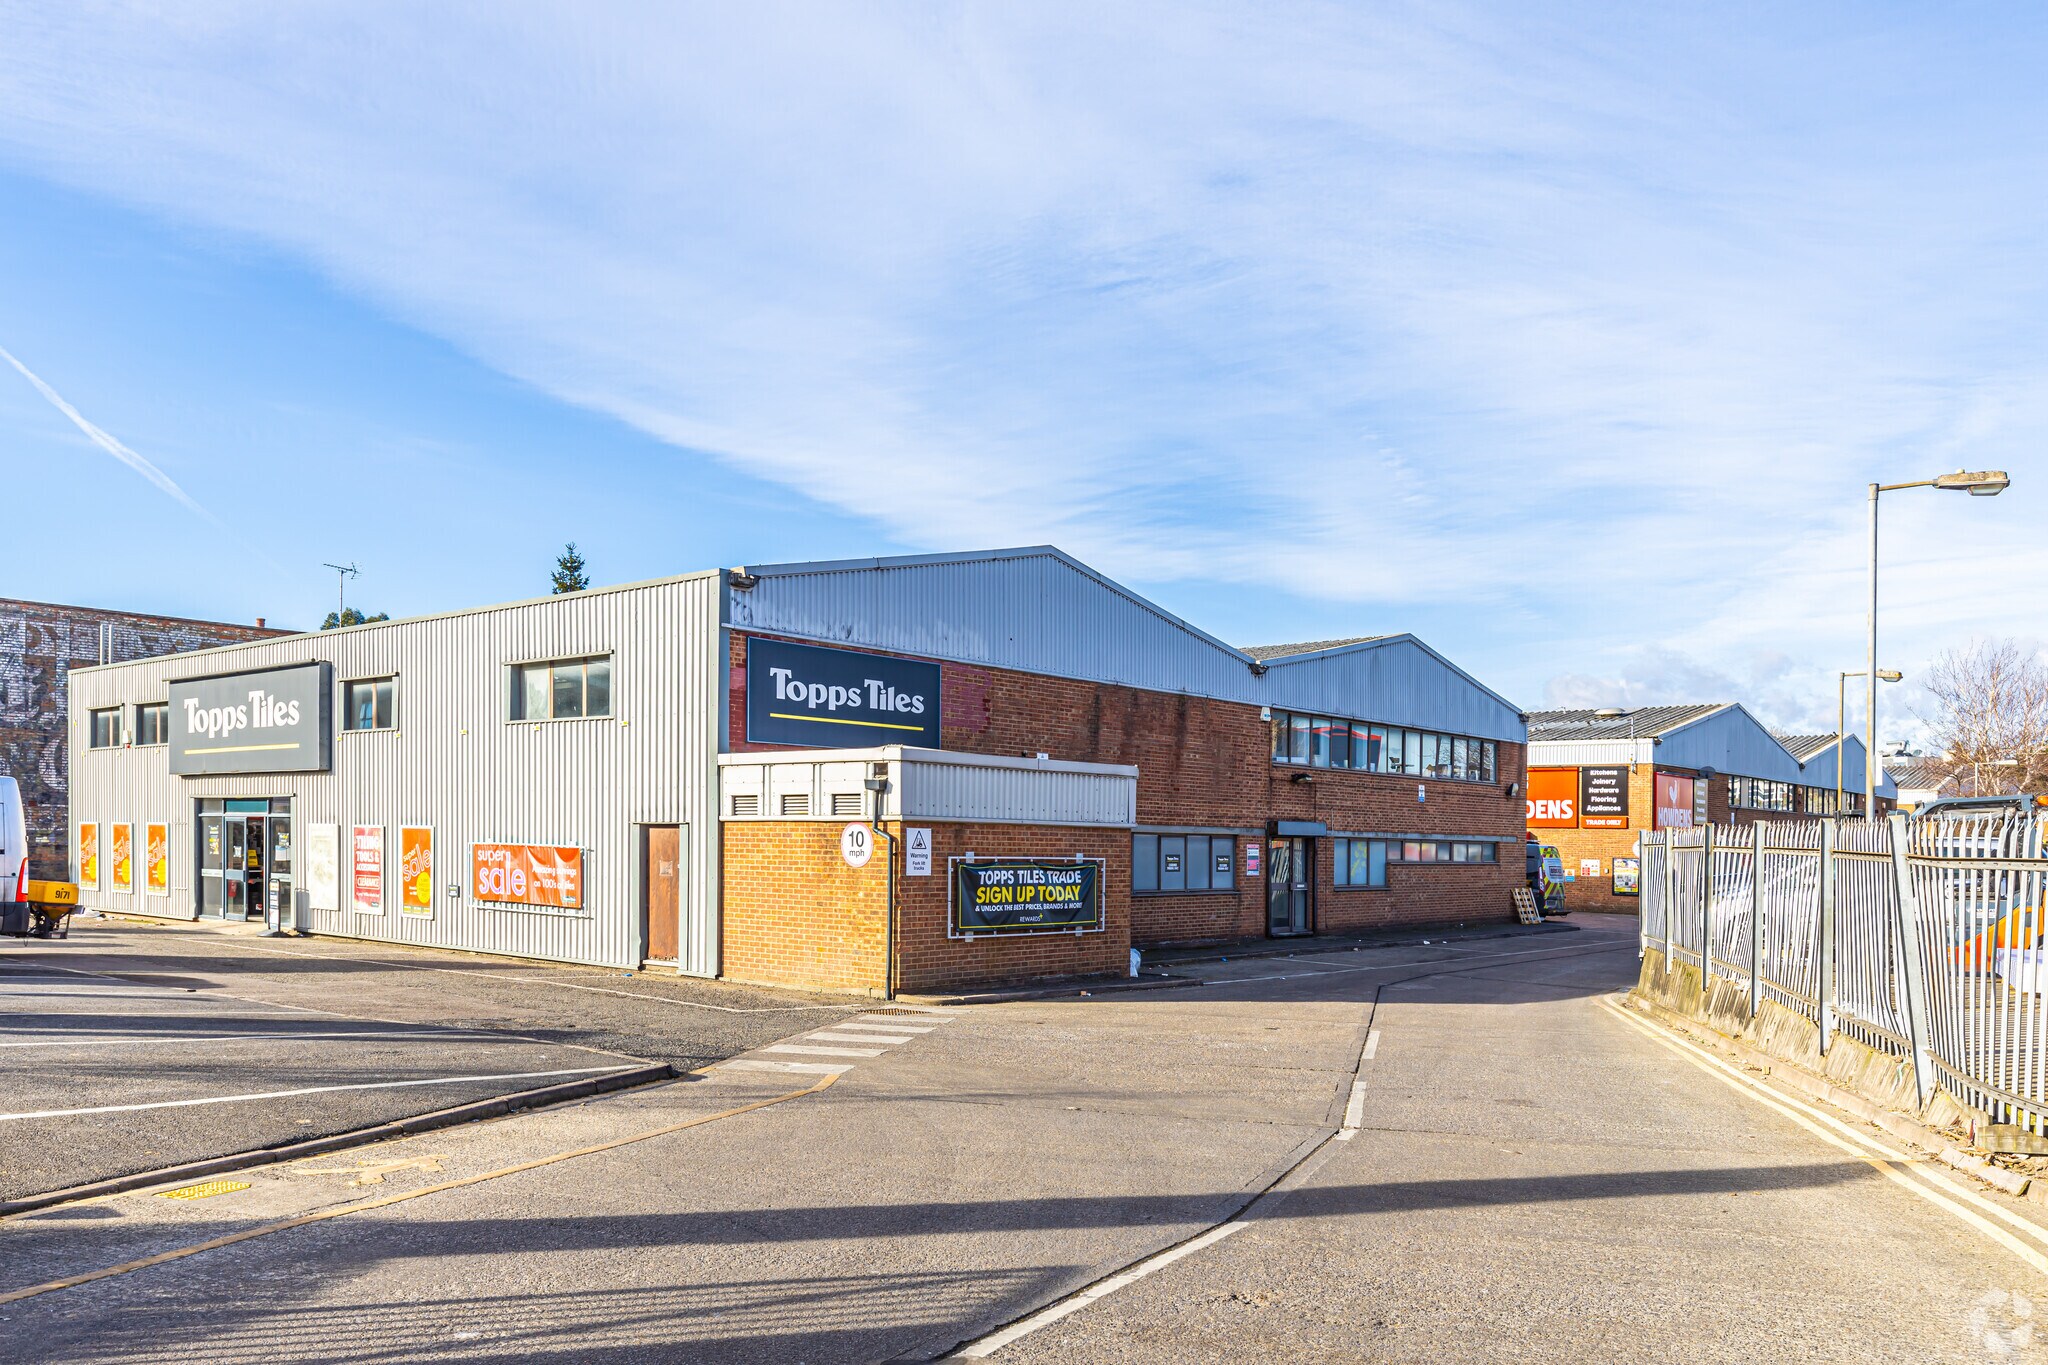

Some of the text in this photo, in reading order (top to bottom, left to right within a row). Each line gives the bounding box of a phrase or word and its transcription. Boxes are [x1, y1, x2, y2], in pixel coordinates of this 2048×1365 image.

[768, 667, 925, 714] Topps Tiles
[184, 690, 300, 738] Topps Tiles
[1586, 804, 1622, 812] Appliances
[1658, 806, 1692, 828] HOWDENS
[848, 830, 864, 848] 10
[356, 850, 380, 862] TOOLS &
[478, 850, 506, 866] super
[849, 848, 864, 858] mph
[403, 843, 431, 882] sale
[479, 852, 526, 896] sale
[978, 870, 1081, 885] TOPPS TILES TRADE
[542, 879, 556, 888] 100's
[55, 890, 70, 899] 9171
[976, 886, 1080, 903] SIGN UP TODAY
